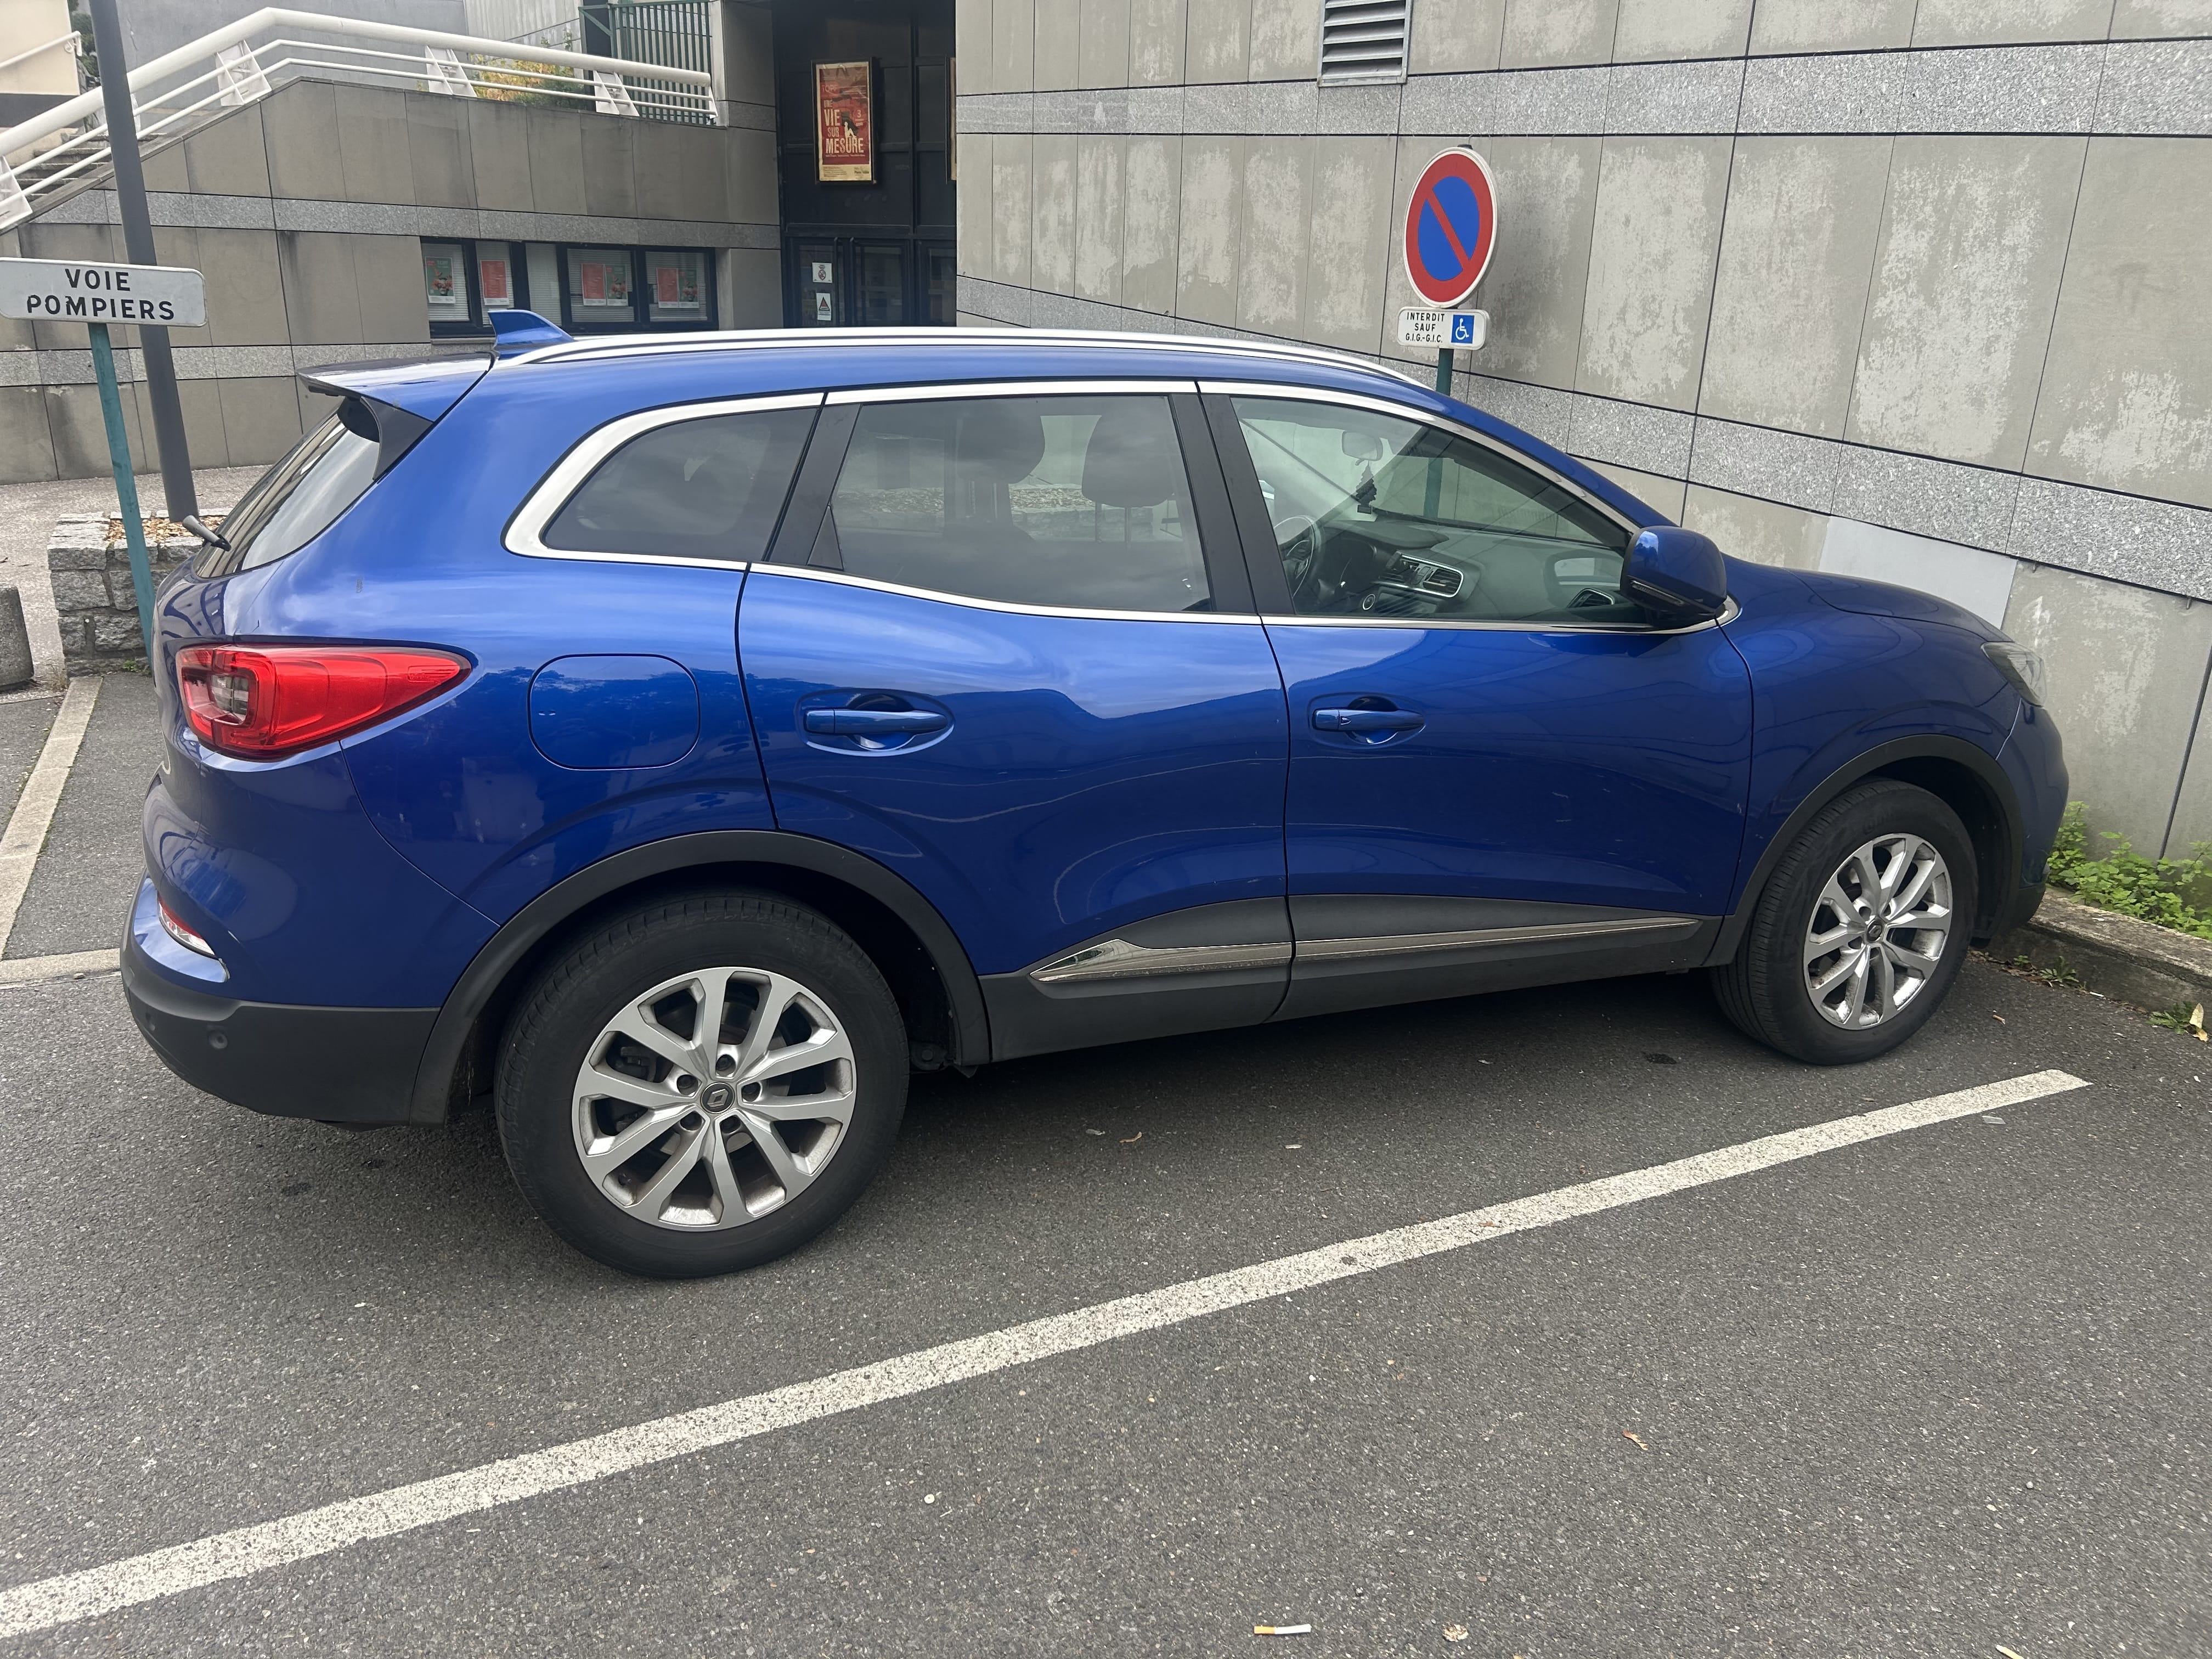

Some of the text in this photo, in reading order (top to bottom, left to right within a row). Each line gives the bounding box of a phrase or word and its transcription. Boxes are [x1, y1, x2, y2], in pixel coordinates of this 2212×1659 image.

[824, 109, 840, 126] VIE
[857, 110, 861, 118] 3
[826, 138, 864, 154] MESURE
[65, 269, 131, 291] VOIE
[27, 295, 174, 320] POMPIERS
[1407, 312, 1444, 321] INTERDIT
[1414, 323, 1436, 331] SAUF
